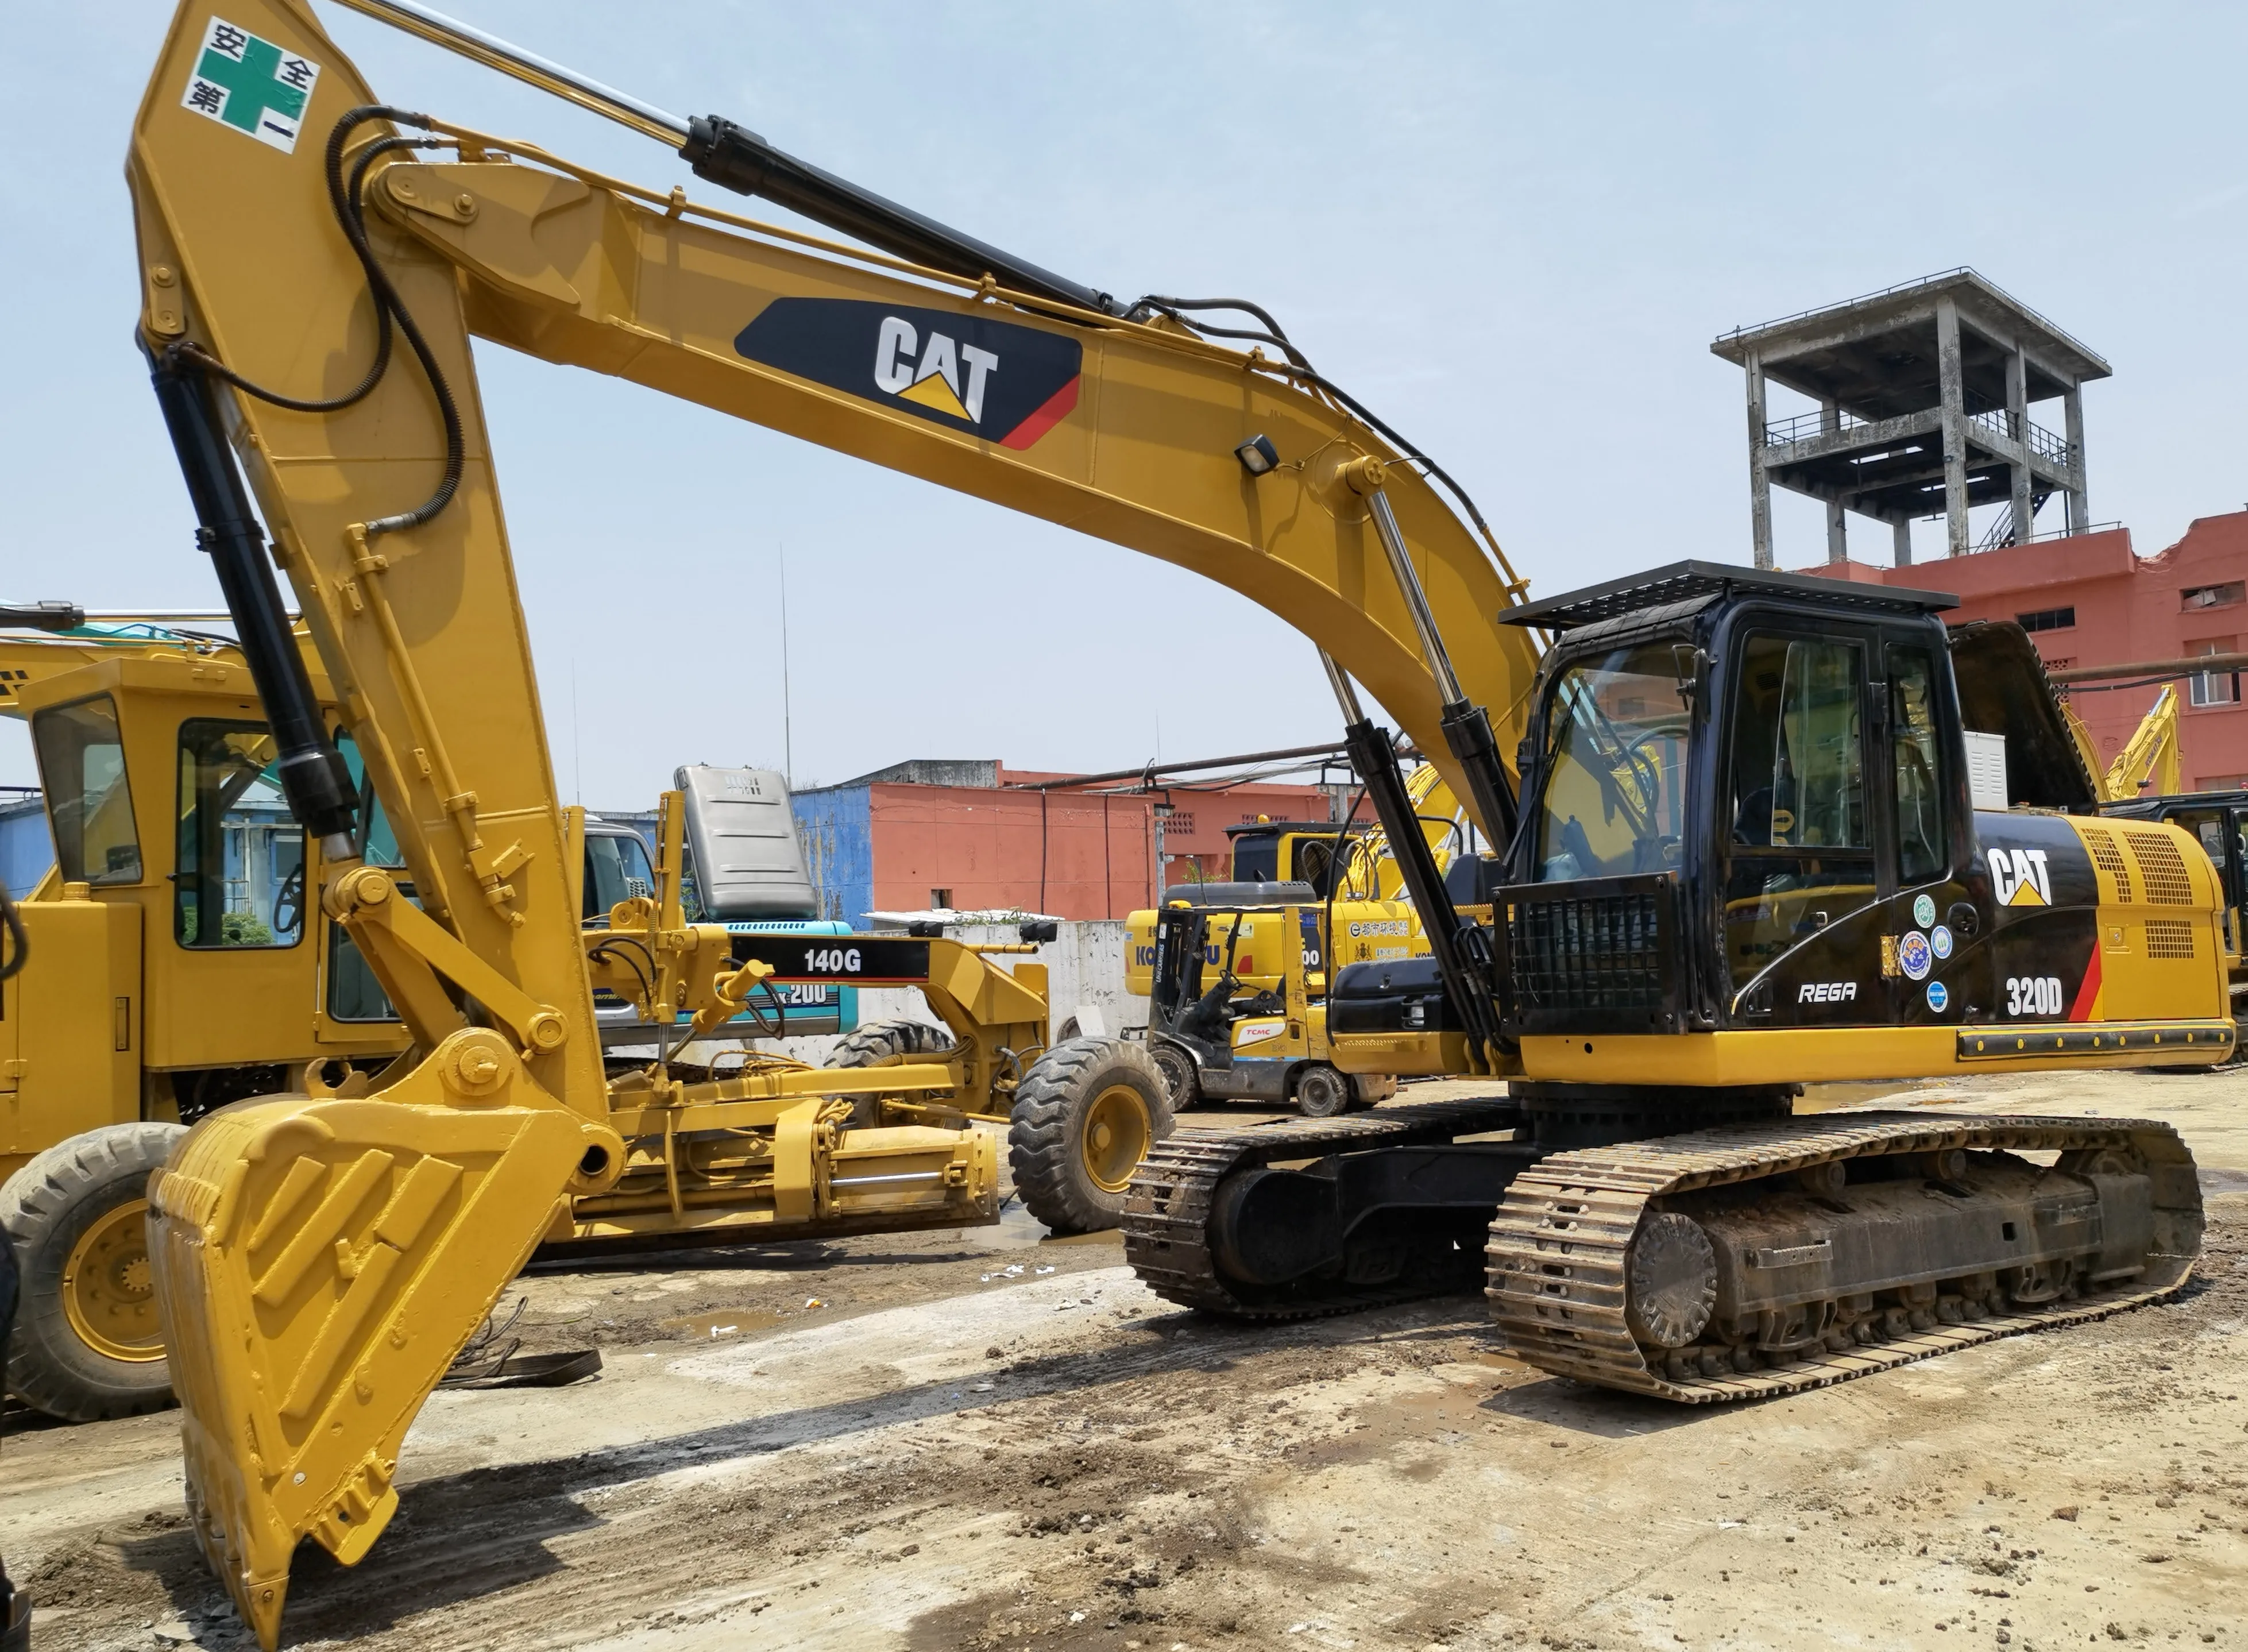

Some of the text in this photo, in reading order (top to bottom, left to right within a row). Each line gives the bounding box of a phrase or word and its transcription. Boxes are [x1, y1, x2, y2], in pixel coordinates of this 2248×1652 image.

[874, 316, 999, 424] CAT
[1987, 847, 2052, 906] CAT
[805, 948, 861, 972] 140G
[1798, 982, 1857, 1003] REGA
[2006, 976, 2062, 1016] 320D
